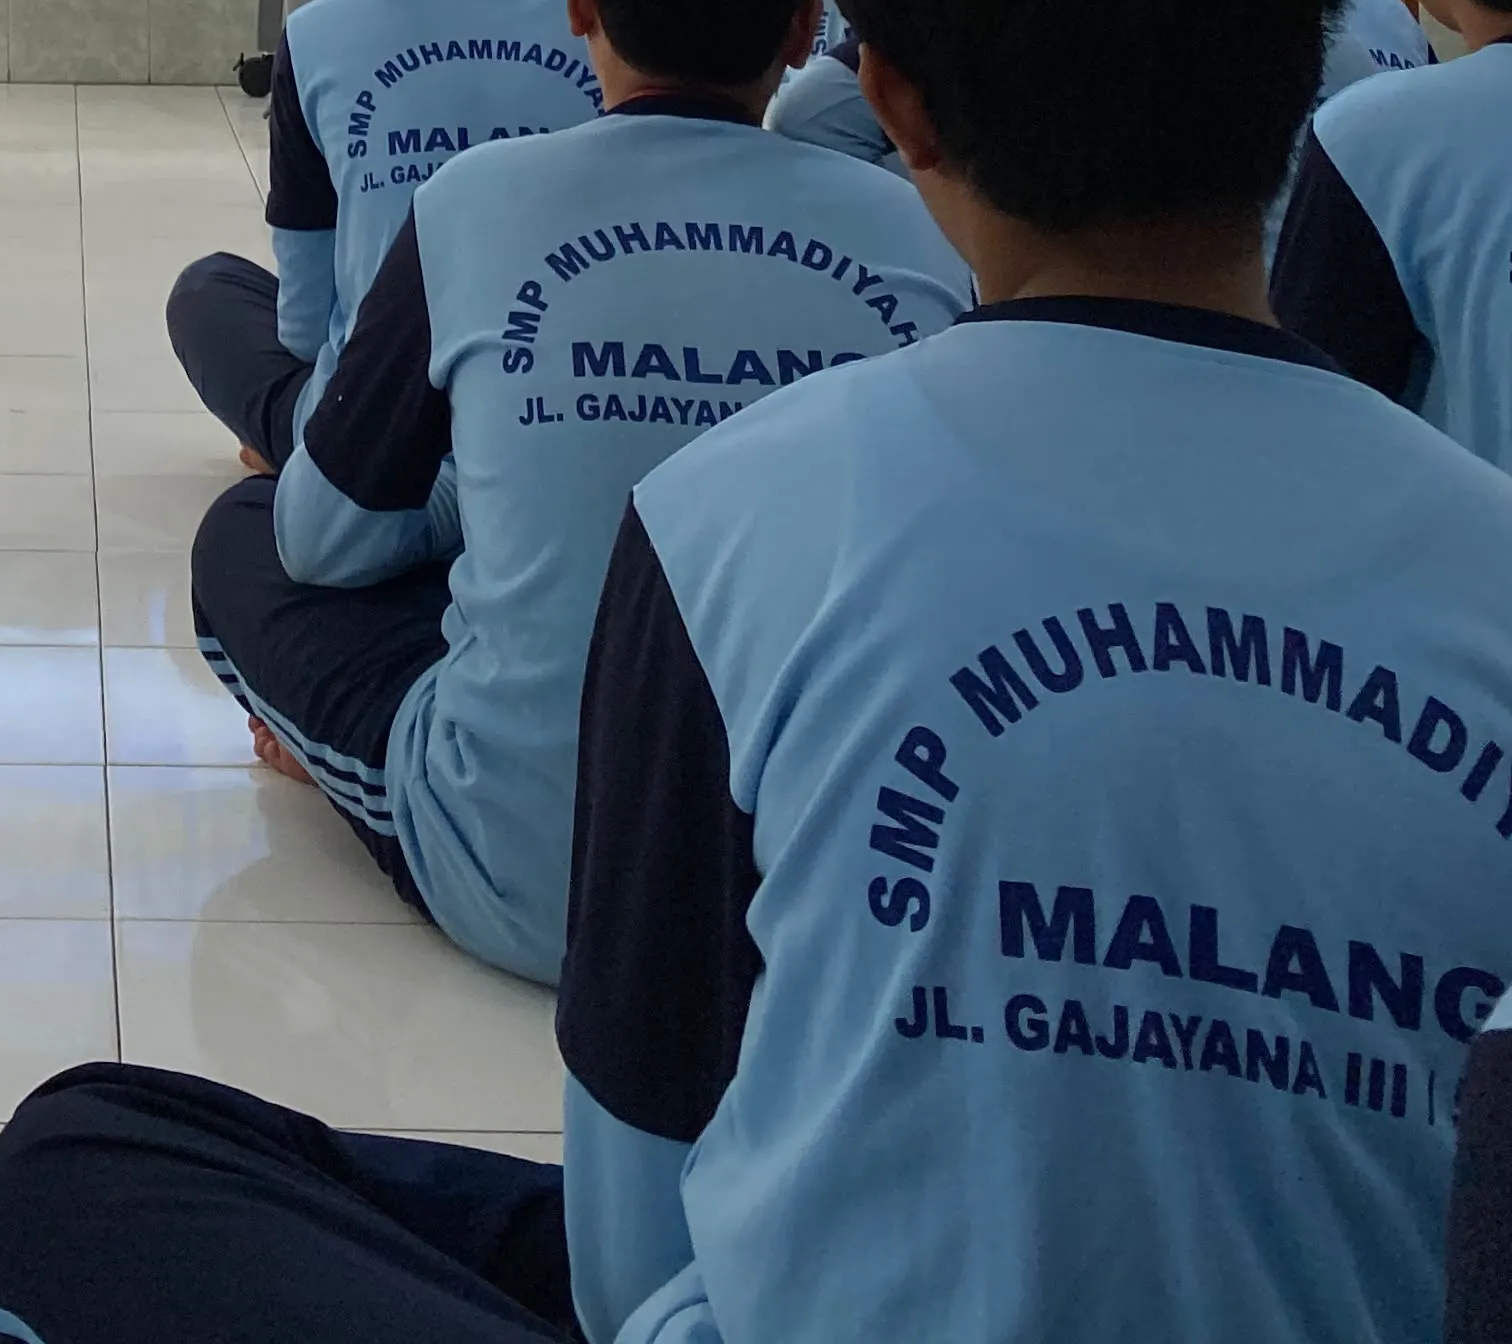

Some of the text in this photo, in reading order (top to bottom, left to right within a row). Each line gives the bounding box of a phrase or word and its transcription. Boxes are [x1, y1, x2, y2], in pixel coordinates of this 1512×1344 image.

[348, 39, 607, 159] SMP MUHAMMADIYA
[360, 172, 385, 193] JL.
[502, 221, 919, 374] SMP MUHAMMADIYAH
[518, 393, 745, 427] JL. GAJAYAN
[867, 725, 961, 933] SMP
[998, 879, 1508, 1045] MALANG
[895, 984, 985, 1044] JL.
[1004, 994, 1328, 1100] GAJAYANA
[1345, 1052, 1408, 1119] III
